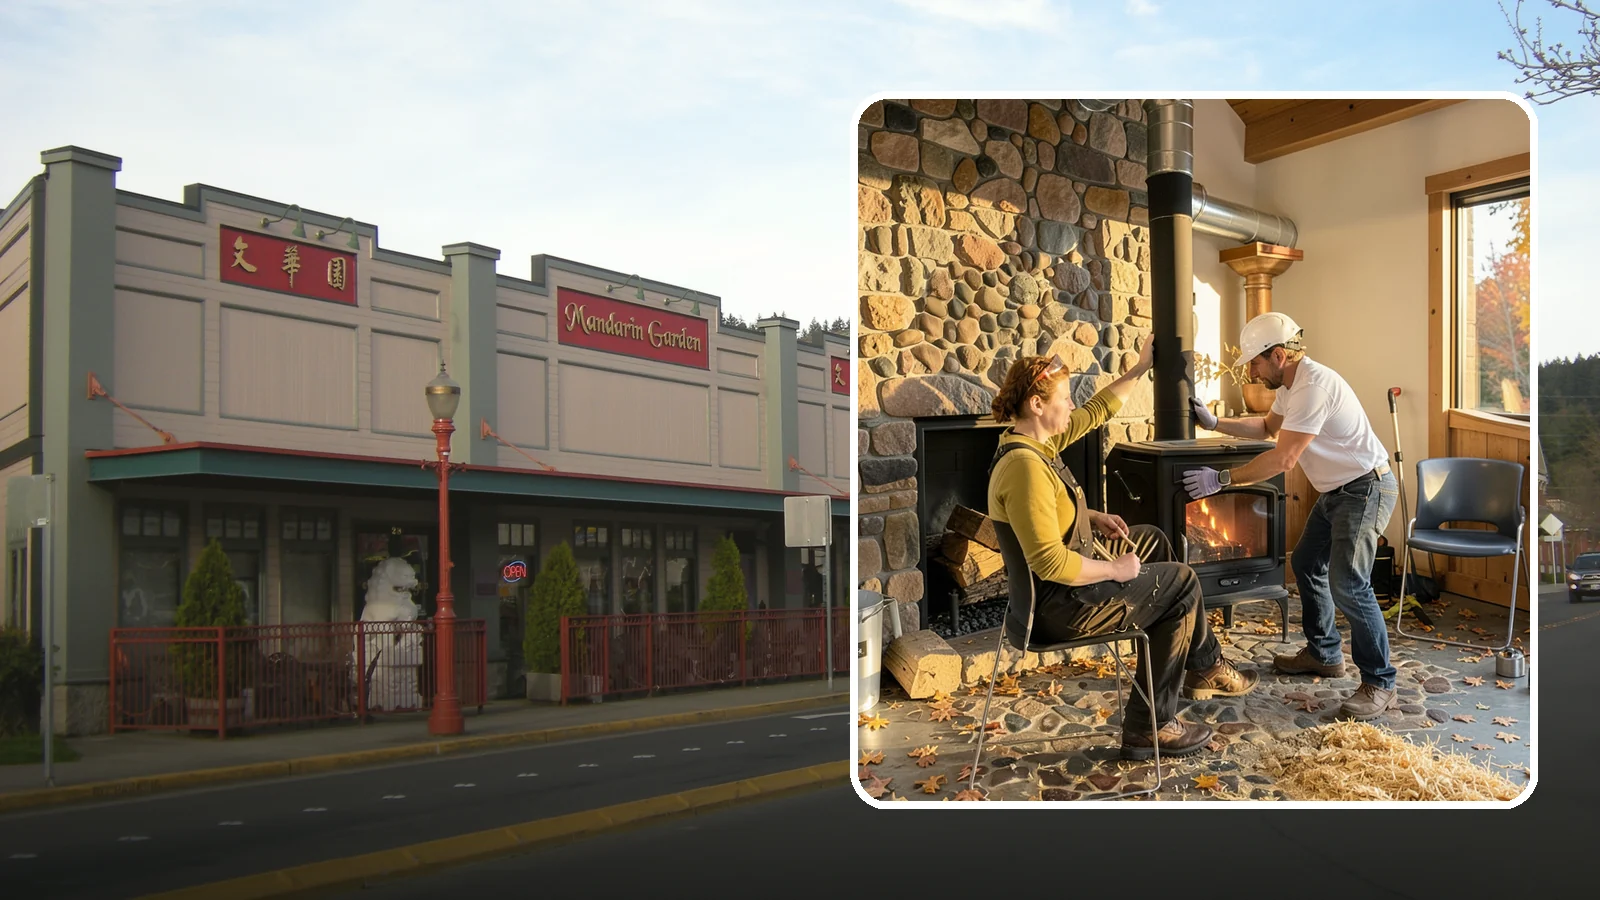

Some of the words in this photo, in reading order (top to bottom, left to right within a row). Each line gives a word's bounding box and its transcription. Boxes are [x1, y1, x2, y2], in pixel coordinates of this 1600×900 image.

[230, 235, 346, 290] 文華園
[564, 302, 644, 341] Mandarin
[647, 320, 701, 352] Garden
[503, 565, 527, 578] OPEN
